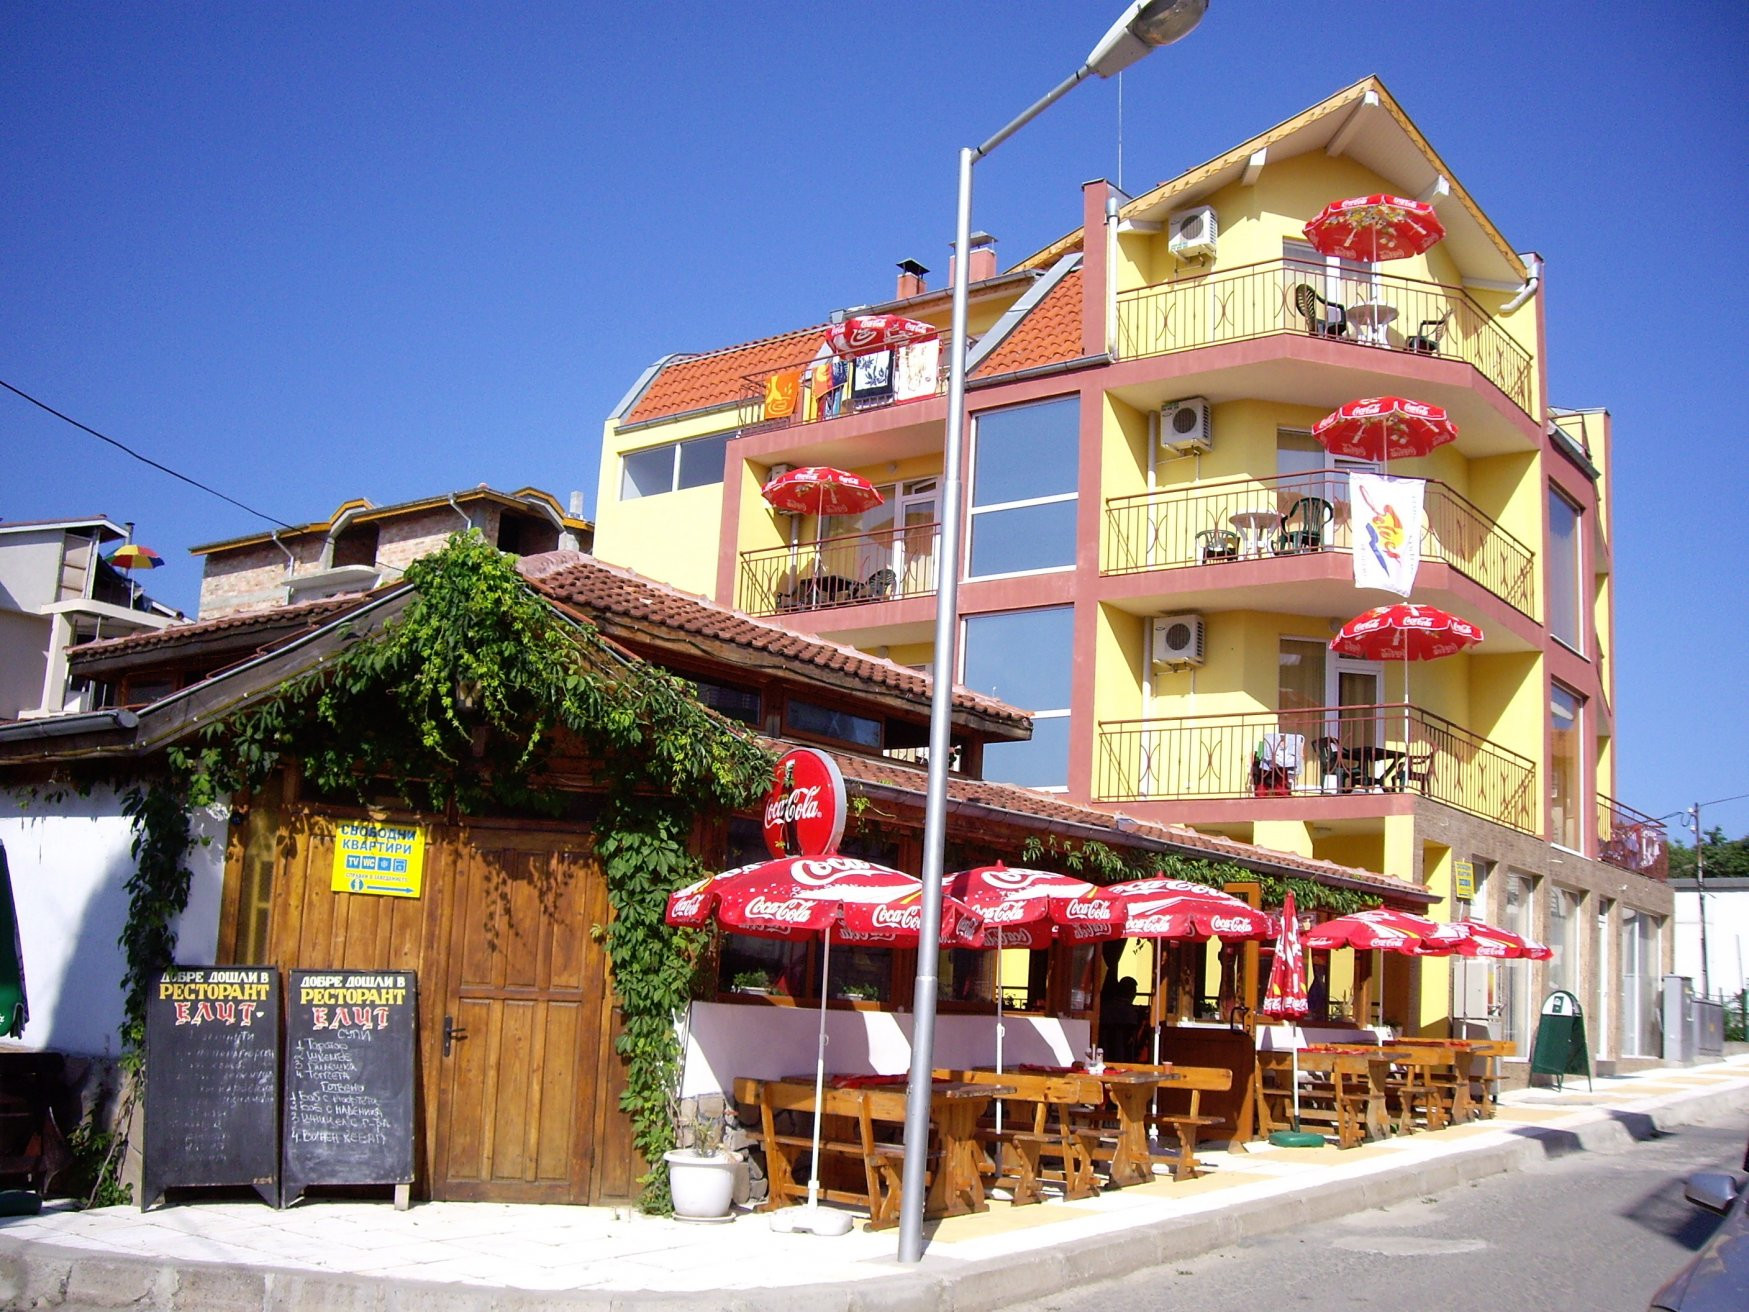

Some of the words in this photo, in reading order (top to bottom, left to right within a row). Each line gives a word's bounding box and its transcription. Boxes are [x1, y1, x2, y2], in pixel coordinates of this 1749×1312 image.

[765, 786, 821, 829] Coca-Cola
[341, 824, 417, 841] СВОБОДНИ
[342, 839, 412, 855] КВАРТИРИ
[348, 857, 359, 867] TV
[363, 858, 376, 868] WC
[745, 896, 818, 924] Coca-Cola
[1066, 899, 1111, 920] Coca-Cola
[1211, 915, 1253, 932] Coca-Cola
[208, 971, 258, 983] ДОШЛИ
[260, 972, 269, 983] В
[300, 976, 343, 987] ДОБРЕ
[345, 976, 393, 987] ДОШЛИ
[396, 977, 406, 987] В
[159, 983, 270, 1000] РЕСТОРАНТ
[300, 988, 406, 1005] РЕСТОРАНТ
